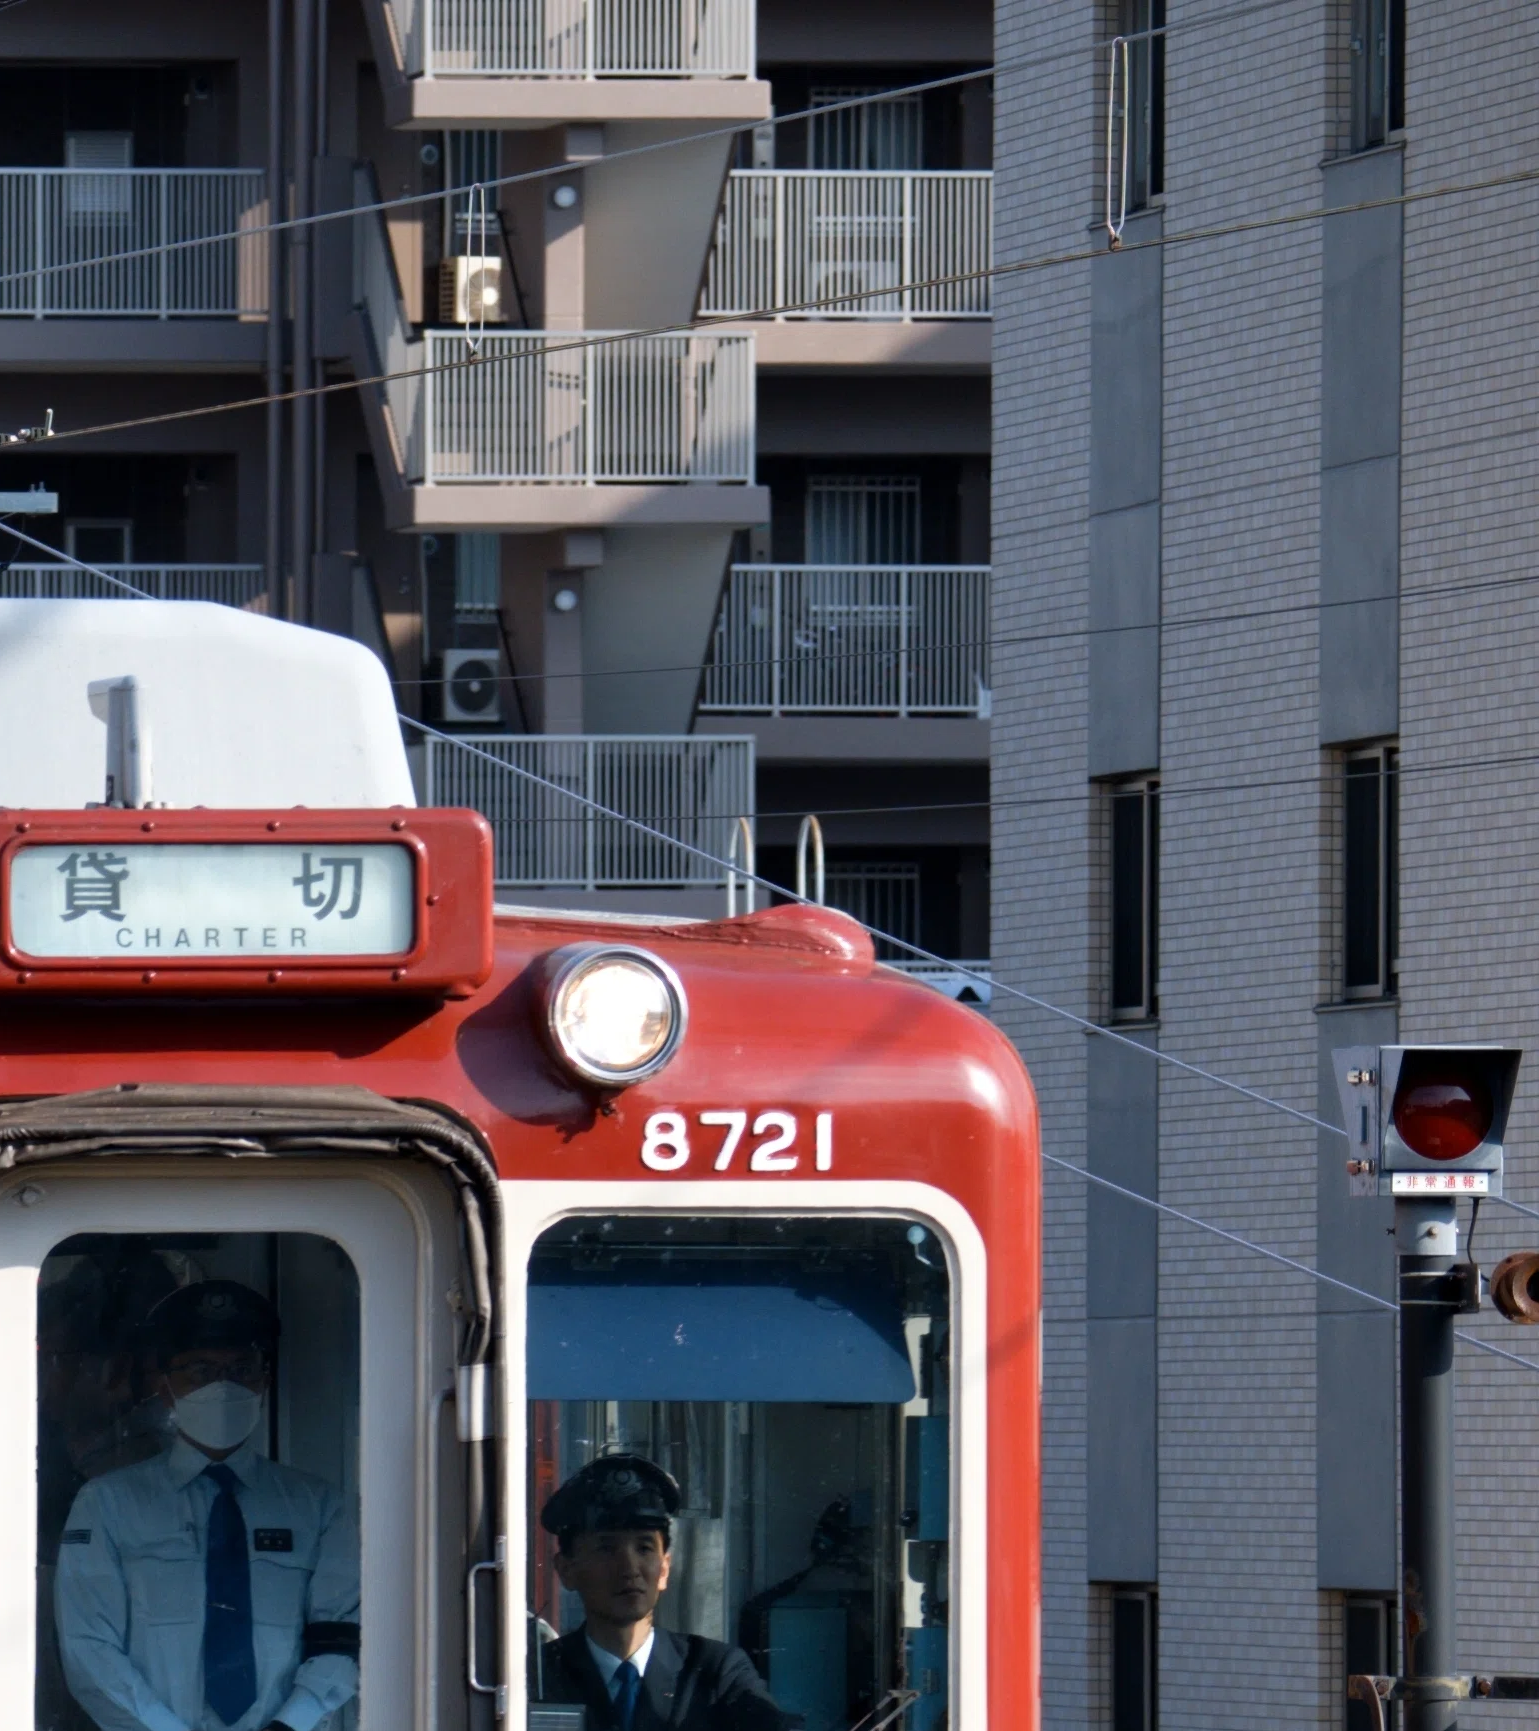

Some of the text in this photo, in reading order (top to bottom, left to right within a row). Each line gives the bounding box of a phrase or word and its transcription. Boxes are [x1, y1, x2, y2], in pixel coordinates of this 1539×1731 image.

[56, 850, 364, 922] 貸切
[115, 926, 308, 949] CHARTER
[641, 1110, 833, 1172] 8721
[1405, 1174, 1476, 1189] 非常通報
